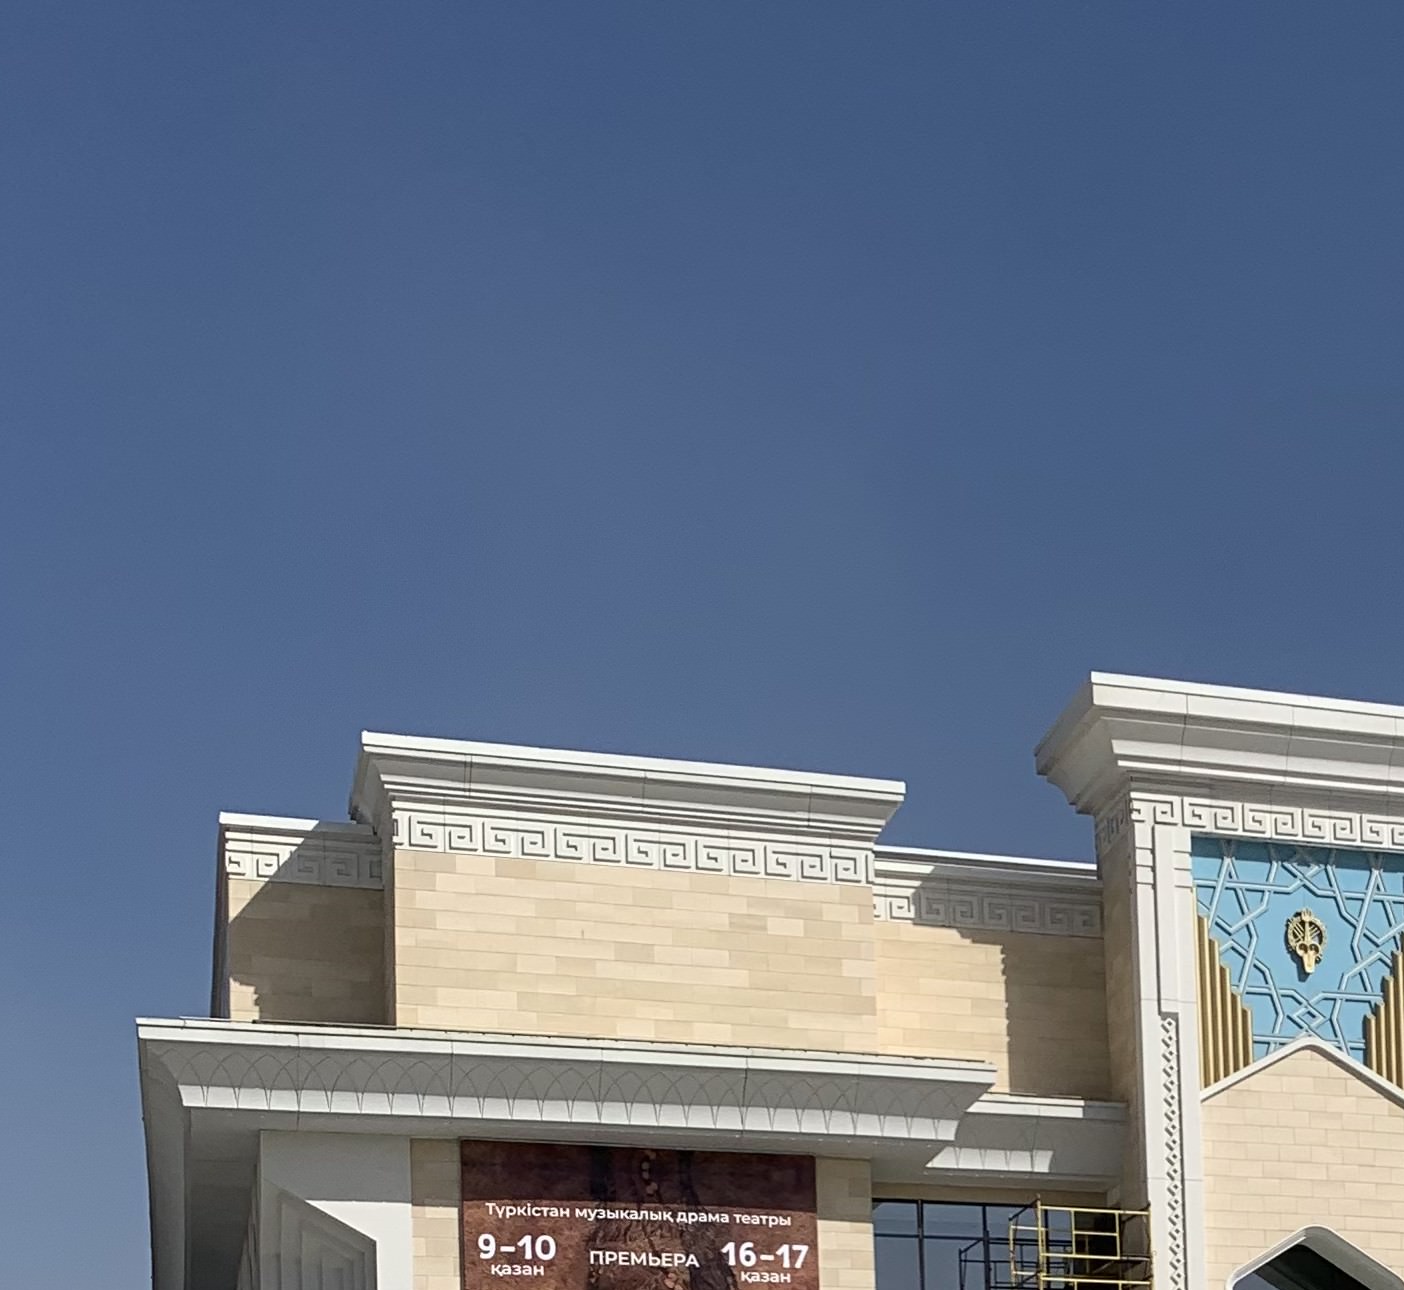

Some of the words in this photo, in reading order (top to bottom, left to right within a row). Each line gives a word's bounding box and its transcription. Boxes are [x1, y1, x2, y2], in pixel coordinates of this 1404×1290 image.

[485, 1202, 570, 1219] Түркістан
[575, 1207, 674, 1223] музыкалық
[676, 1211, 729, 1225] драма
[733, 1213, 791, 1228] театры
[589, 1250, 701, 1268] ПРЕМЬЕРА
[491, 1264, 545, 1277] қазан
[741, 1271, 791, 1283] қазан
